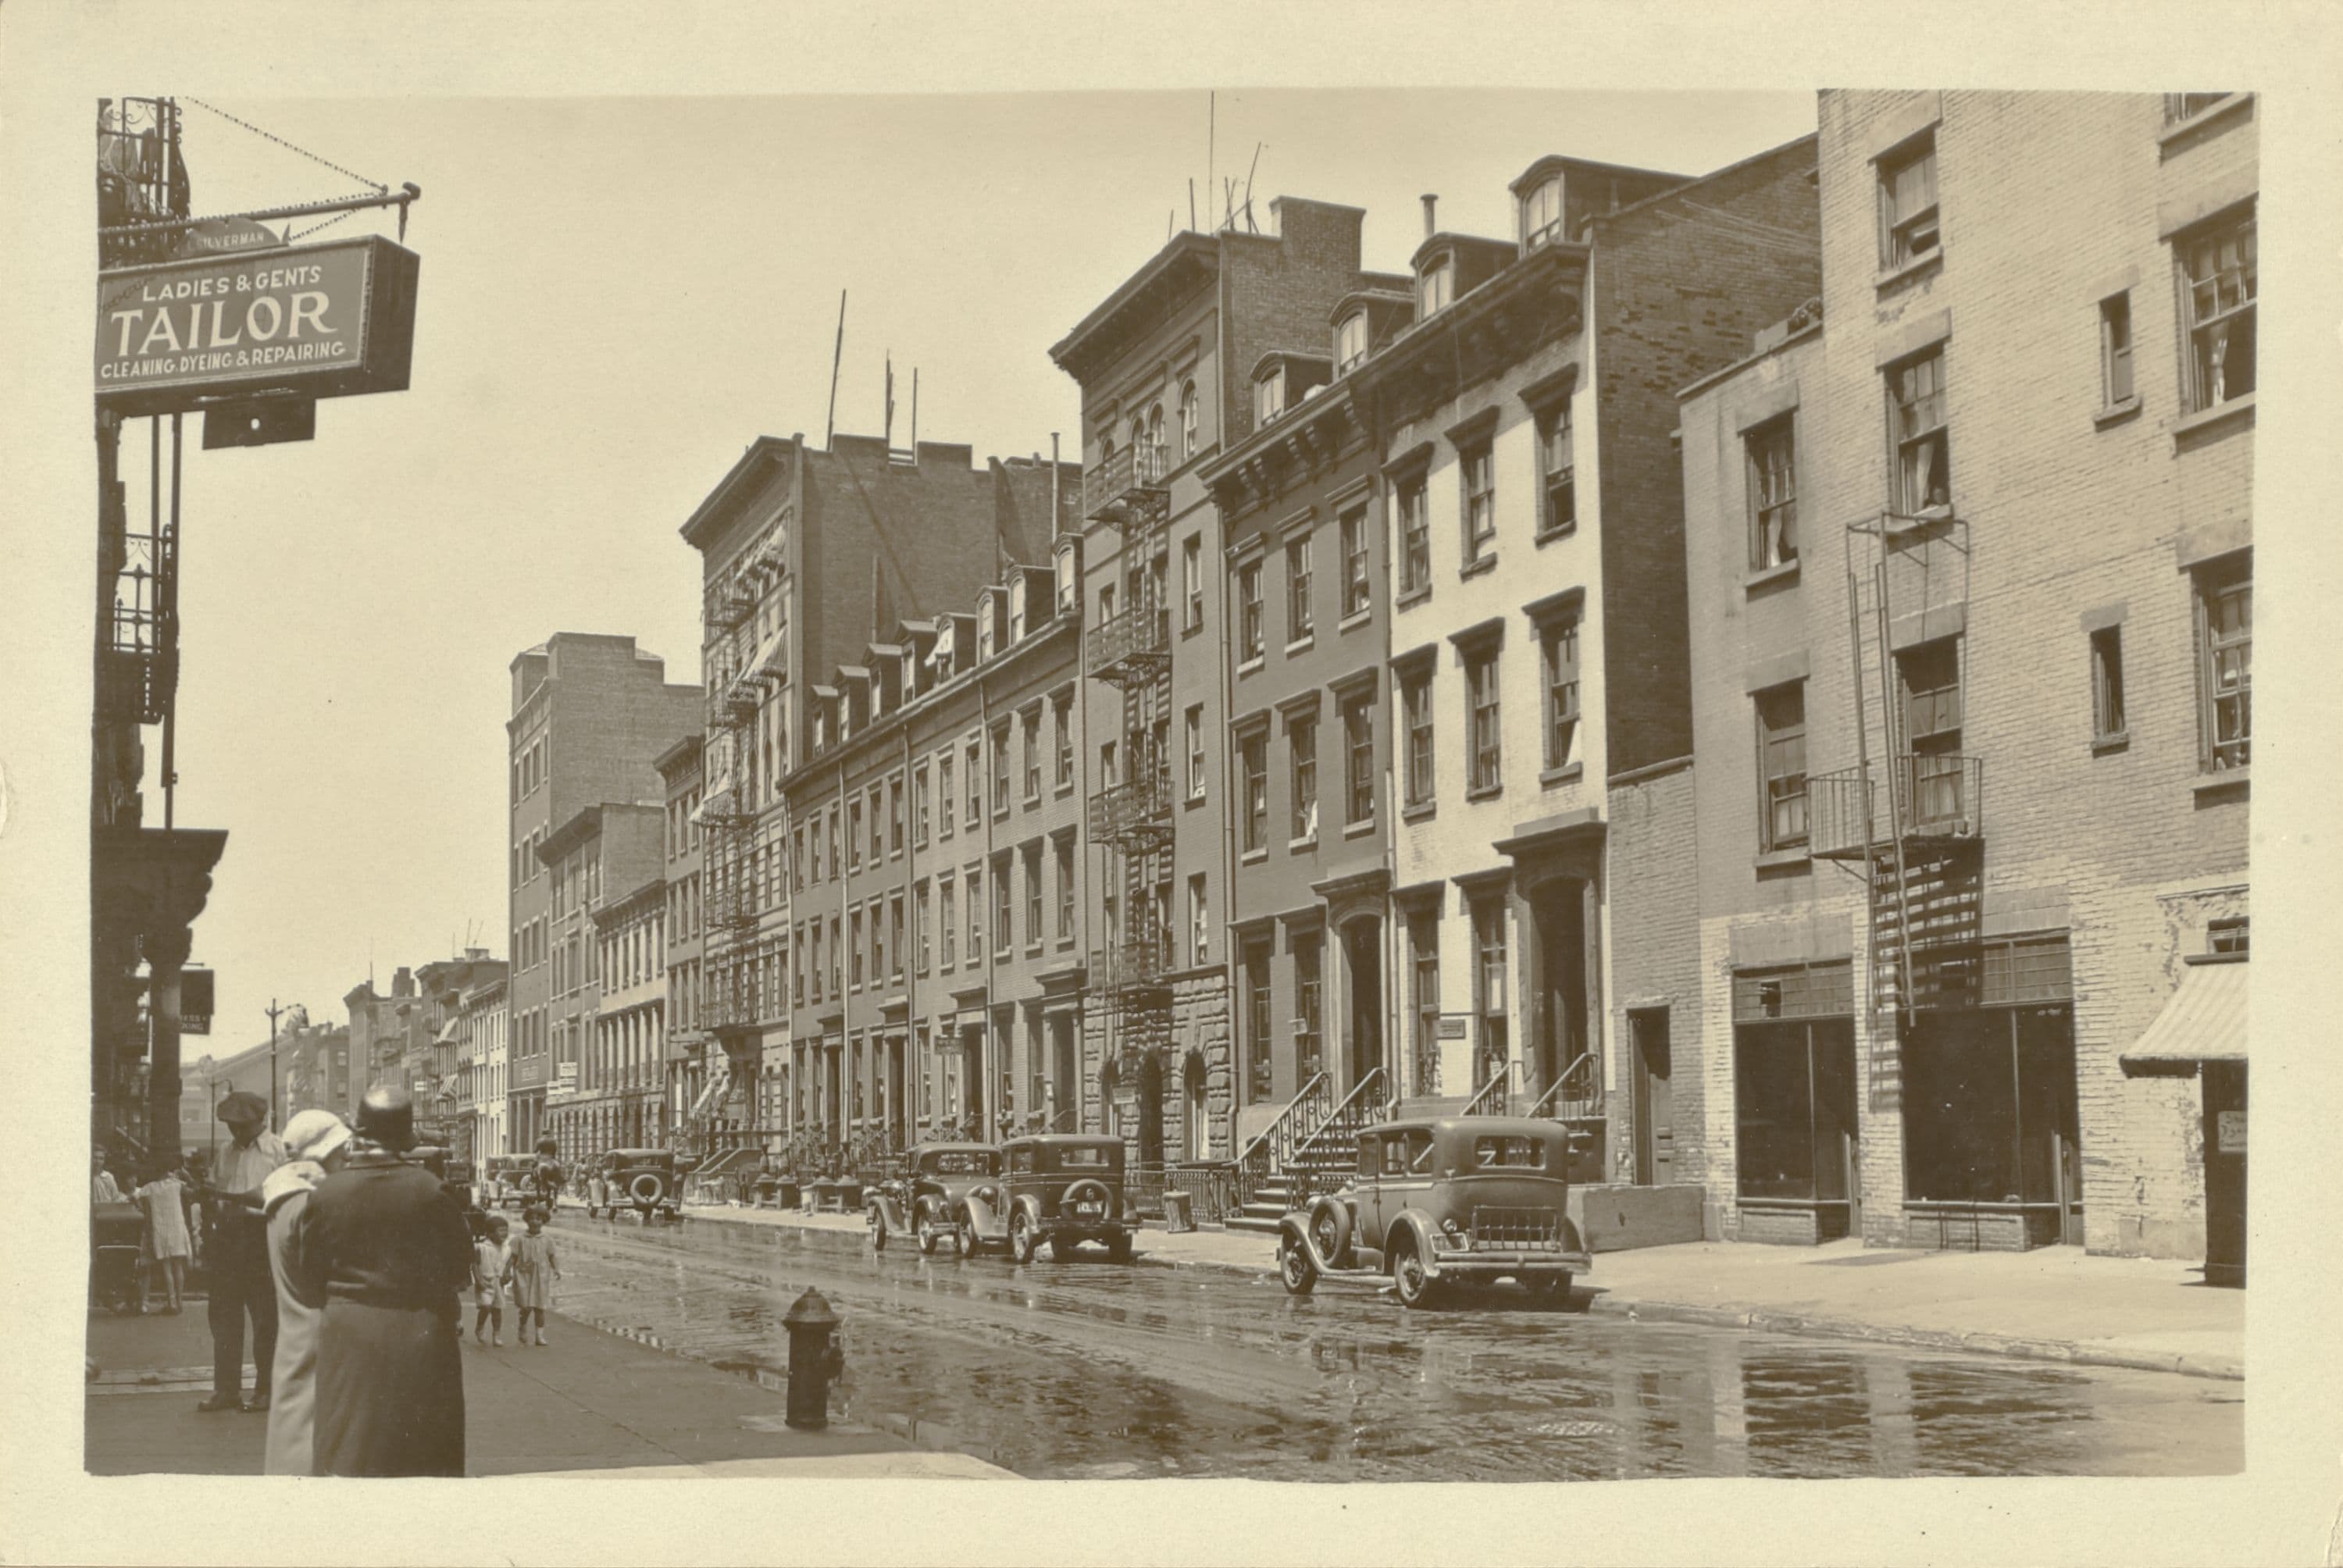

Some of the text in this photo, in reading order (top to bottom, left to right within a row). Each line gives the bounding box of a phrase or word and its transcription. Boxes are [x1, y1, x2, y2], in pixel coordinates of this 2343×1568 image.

[142, 265, 322, 302] LADIES & GENTS
[111, 290, 338, 358] TAILOR
[180, 351, 232, 372] DYEING
[236, 351, 249, 367] &
[251, 341, 346, 365] REPAIRING
